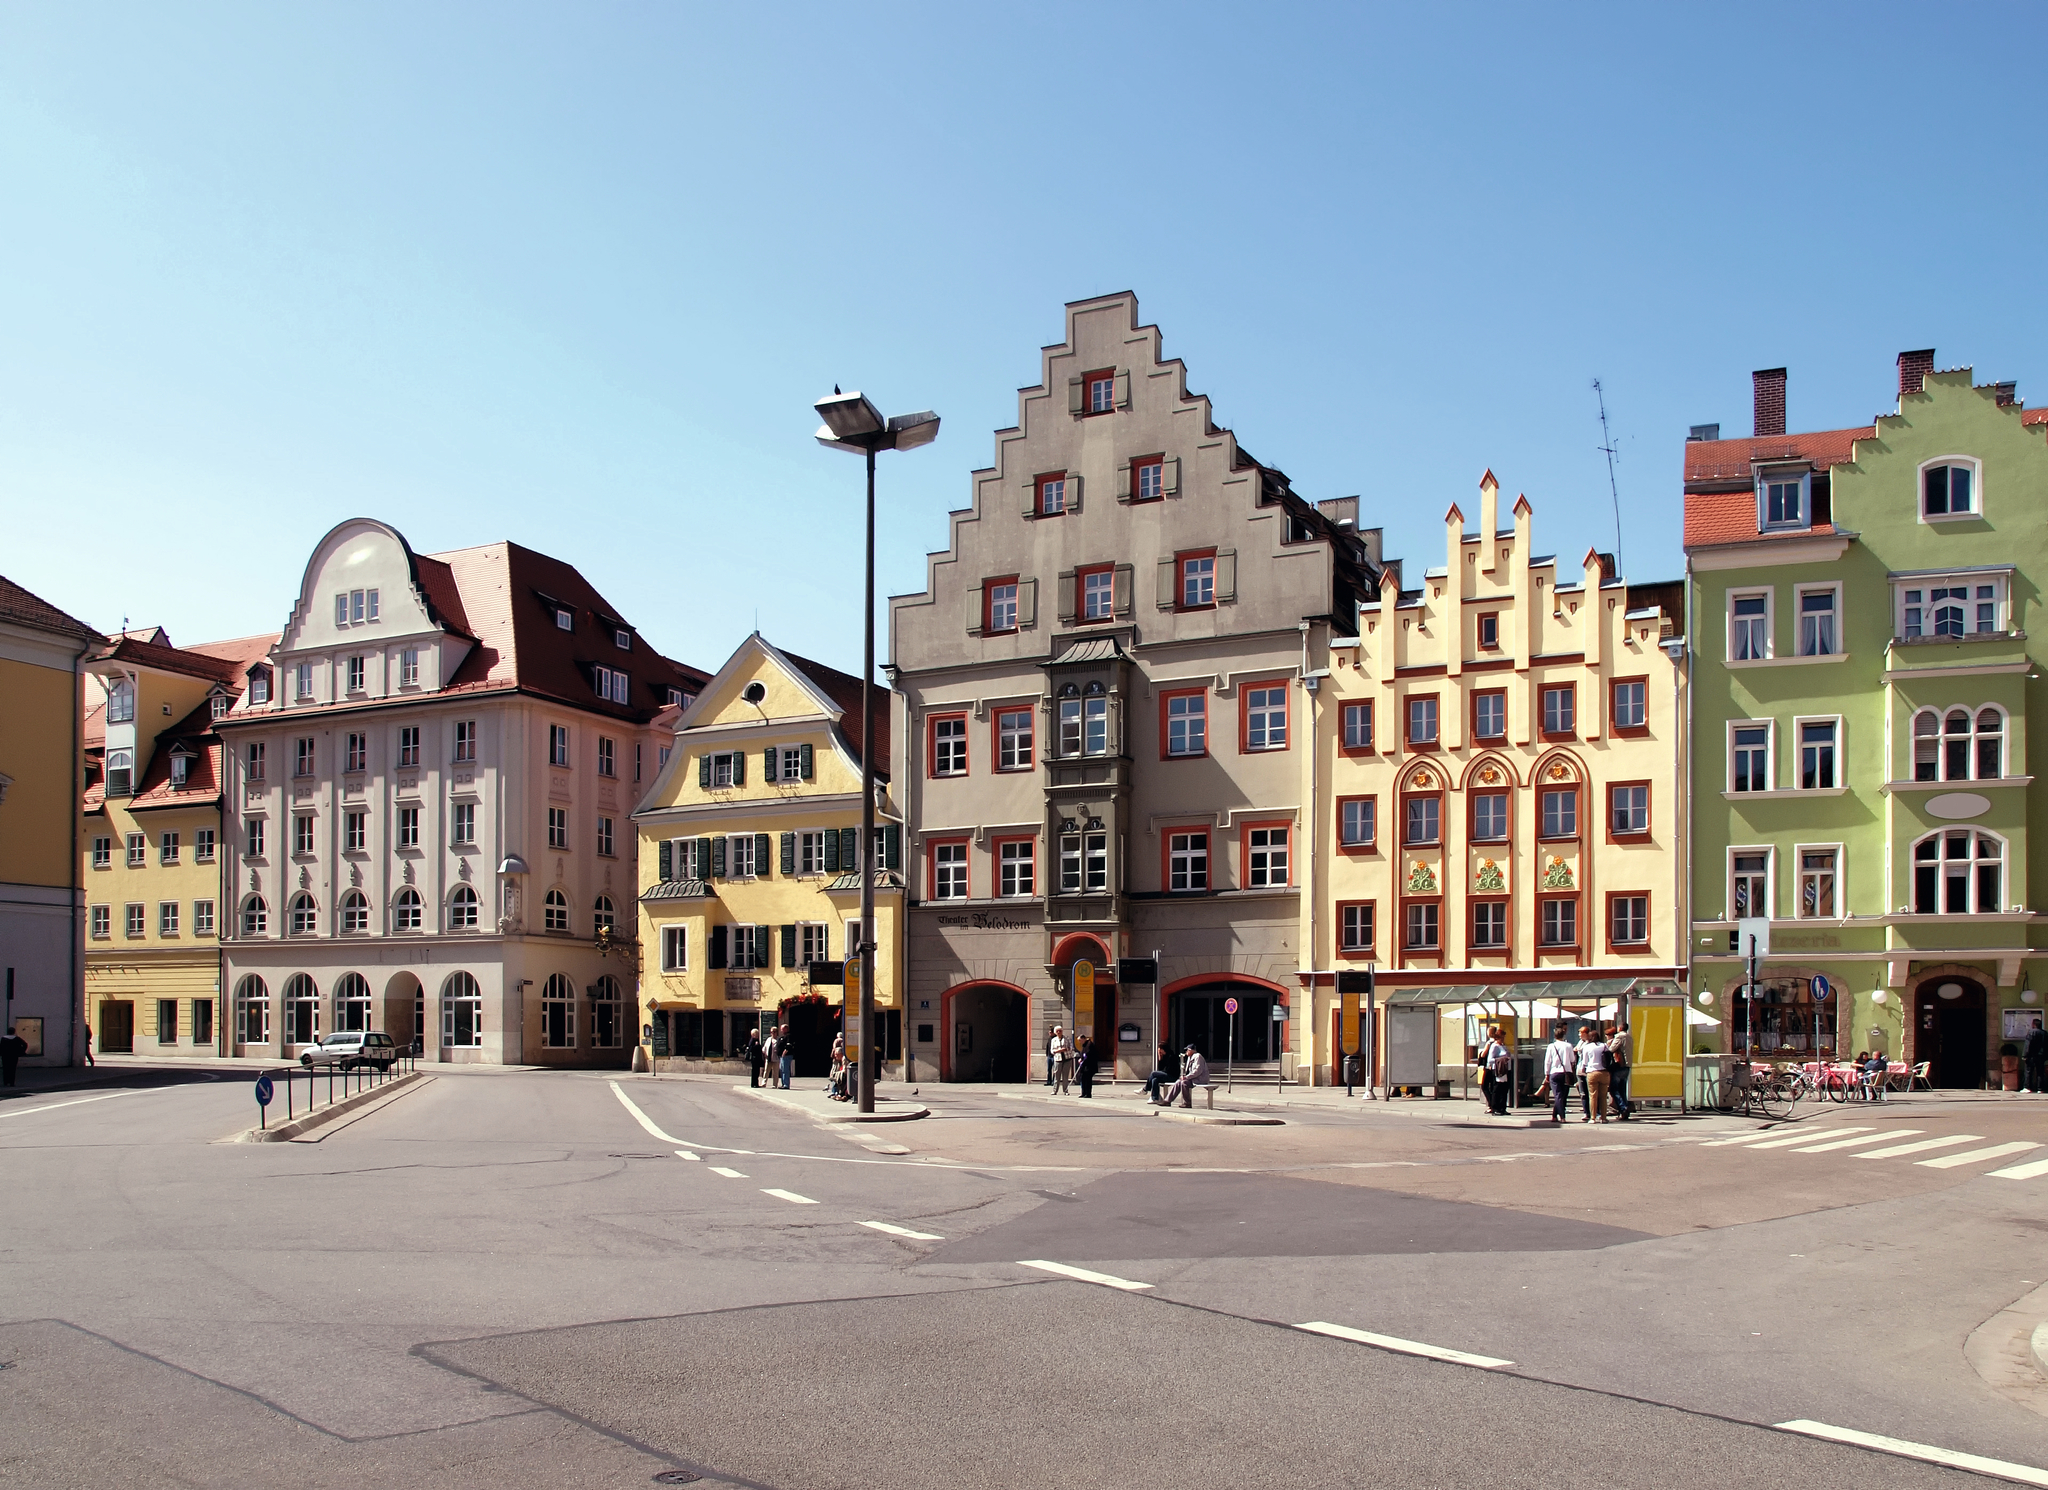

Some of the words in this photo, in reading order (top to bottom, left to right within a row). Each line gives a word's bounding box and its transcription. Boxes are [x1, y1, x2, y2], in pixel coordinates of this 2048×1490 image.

[938, 915, 968, 924] Theater
[971, 911, 1031, 930] Velodrom
[1770, 932, 1841, 948] izzeria
